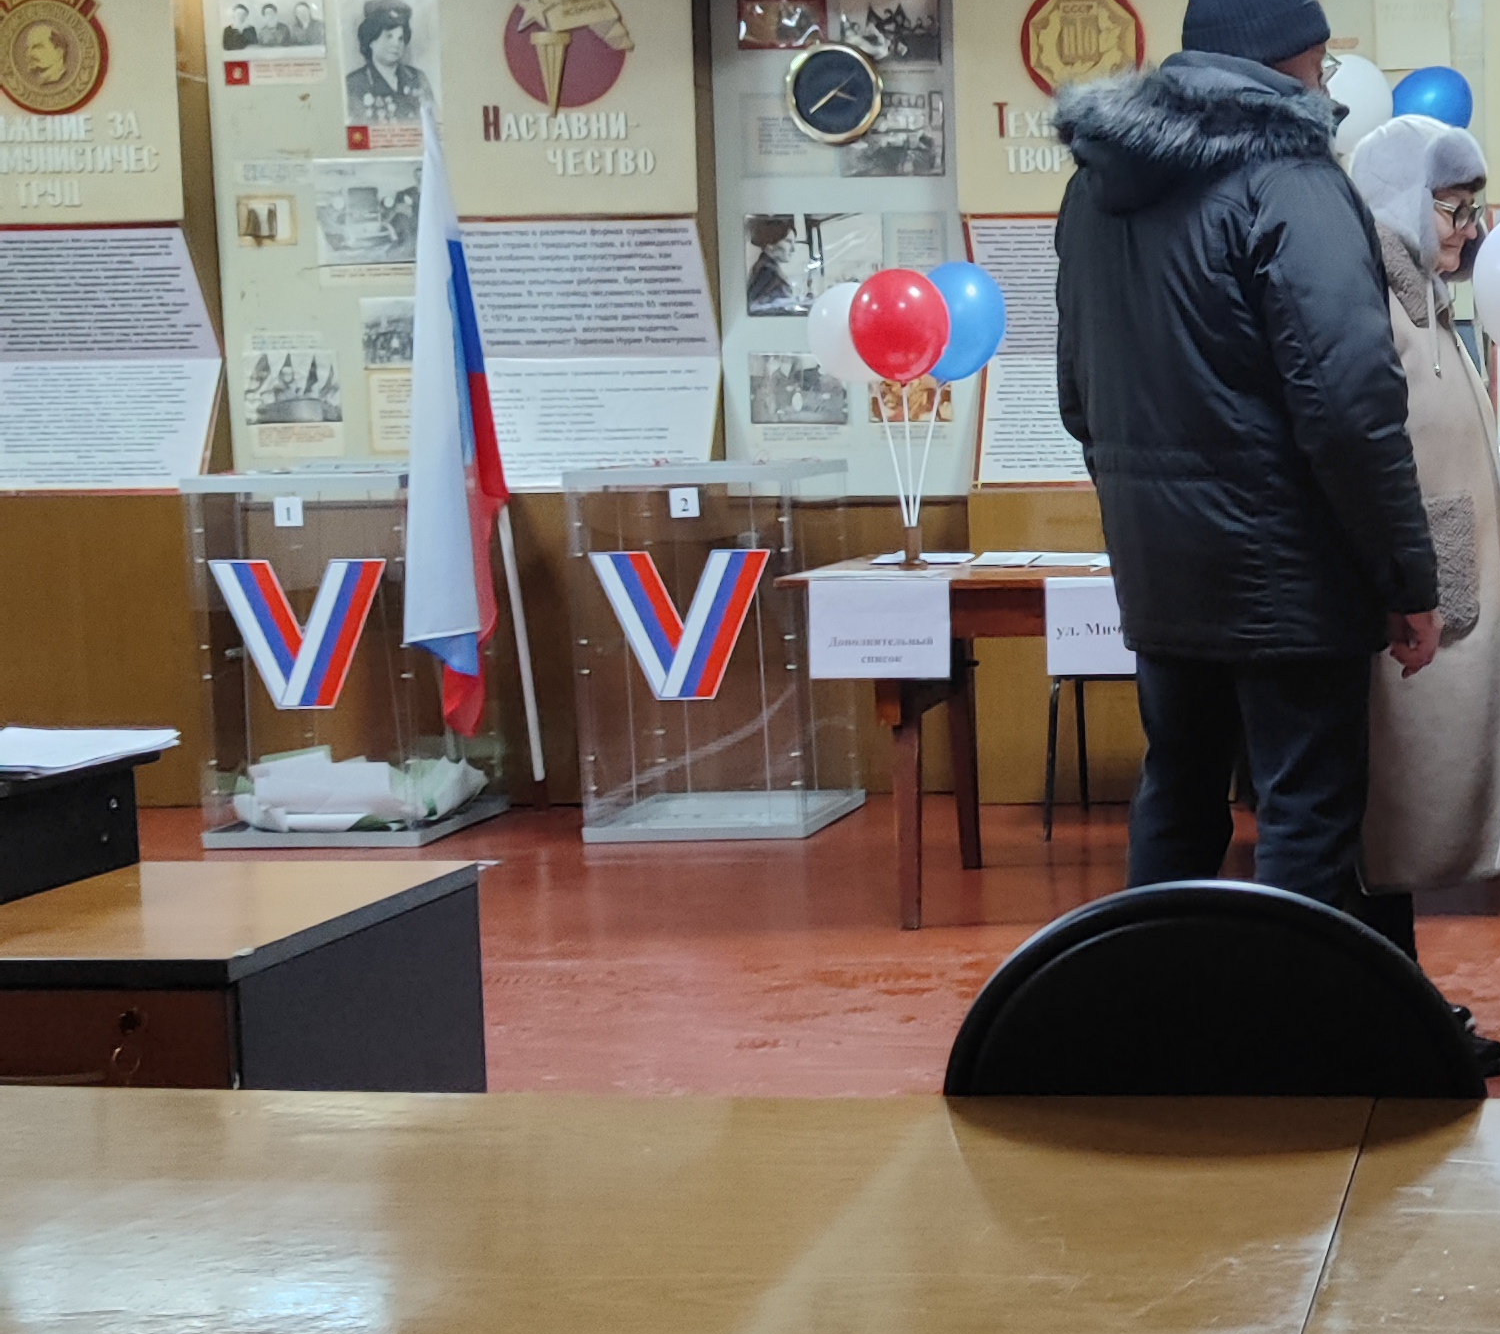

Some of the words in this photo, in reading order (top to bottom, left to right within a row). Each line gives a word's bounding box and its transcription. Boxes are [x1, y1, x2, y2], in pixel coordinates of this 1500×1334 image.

[107, 111, 141, 140] ЗА
[547, 147, 656, 176] ЧЕСТВО
[17, 179, 82, 208] ТРУД
[680, 497, 689, 512] 2
[1056, 627, 1080, 640] ул.
[828, 636, 934, 648] Дополнительный
[861, 655, 903, 664] список
